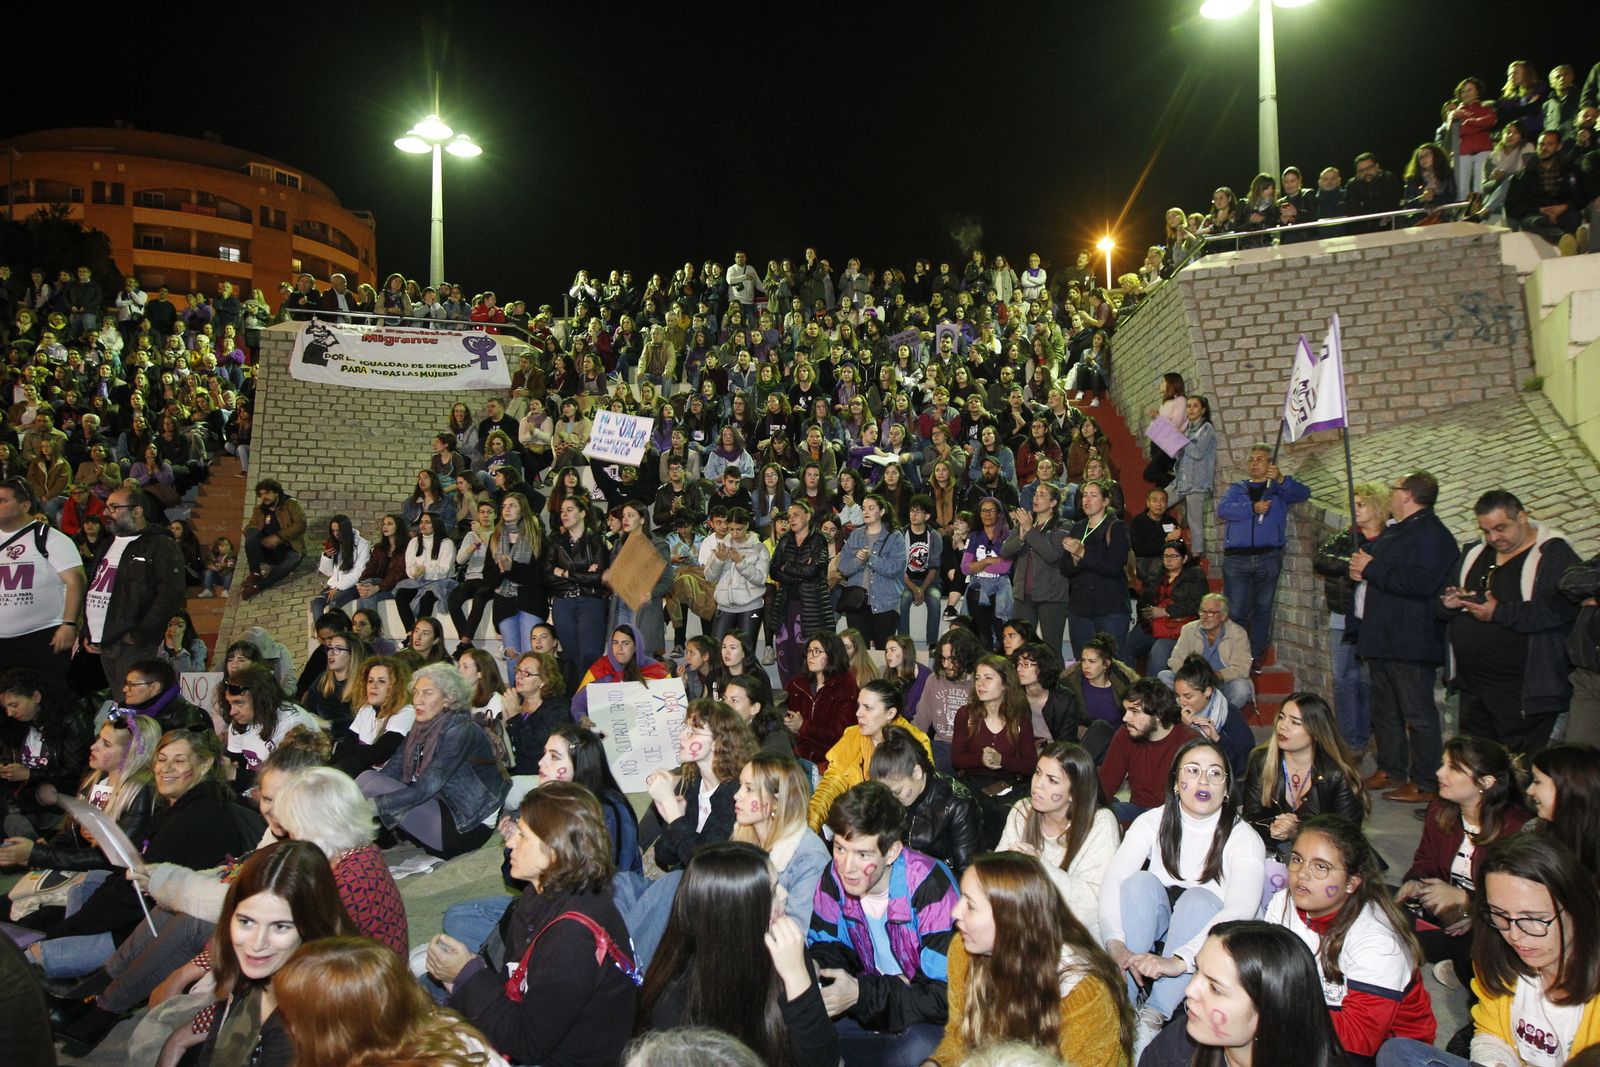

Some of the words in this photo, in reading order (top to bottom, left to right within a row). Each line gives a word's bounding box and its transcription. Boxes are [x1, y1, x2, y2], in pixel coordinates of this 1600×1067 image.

[324, 353, 345, 361] POR
[360, 360, 409, 368] IGUALDAD
[340, 365, 368, 374] PARA
[370, 369, 401, 377] TODAS
[420, 370, 458, 378] MUJERES
[607, 690, 625, 713] TANTO
[611, 719, 633, 753] QUITARON
[643, 746, 663, 763] QUE
[619, 759, 639, 776] NOS
